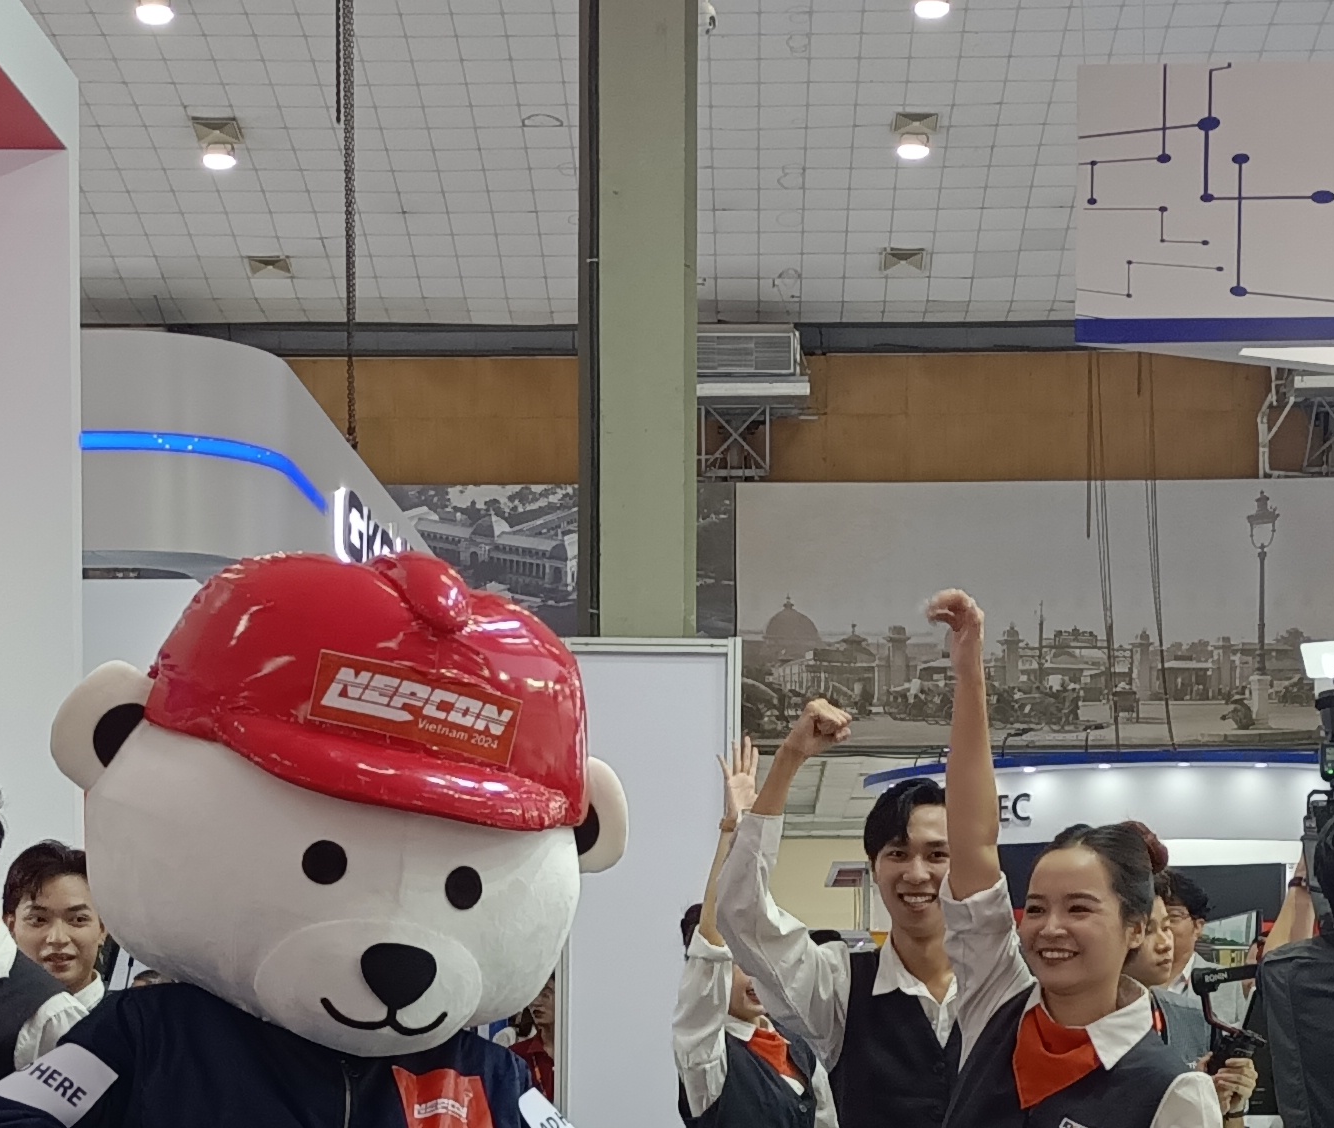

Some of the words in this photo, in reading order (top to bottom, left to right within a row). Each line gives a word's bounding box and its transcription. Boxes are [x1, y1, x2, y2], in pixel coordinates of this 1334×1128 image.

[320, 666, 514, 736] NEPCON
[418, 718, 468, 742] Vietnam
[470, 733, 499, 750] 2024
[28, 1062, 88, 1108] HERE
